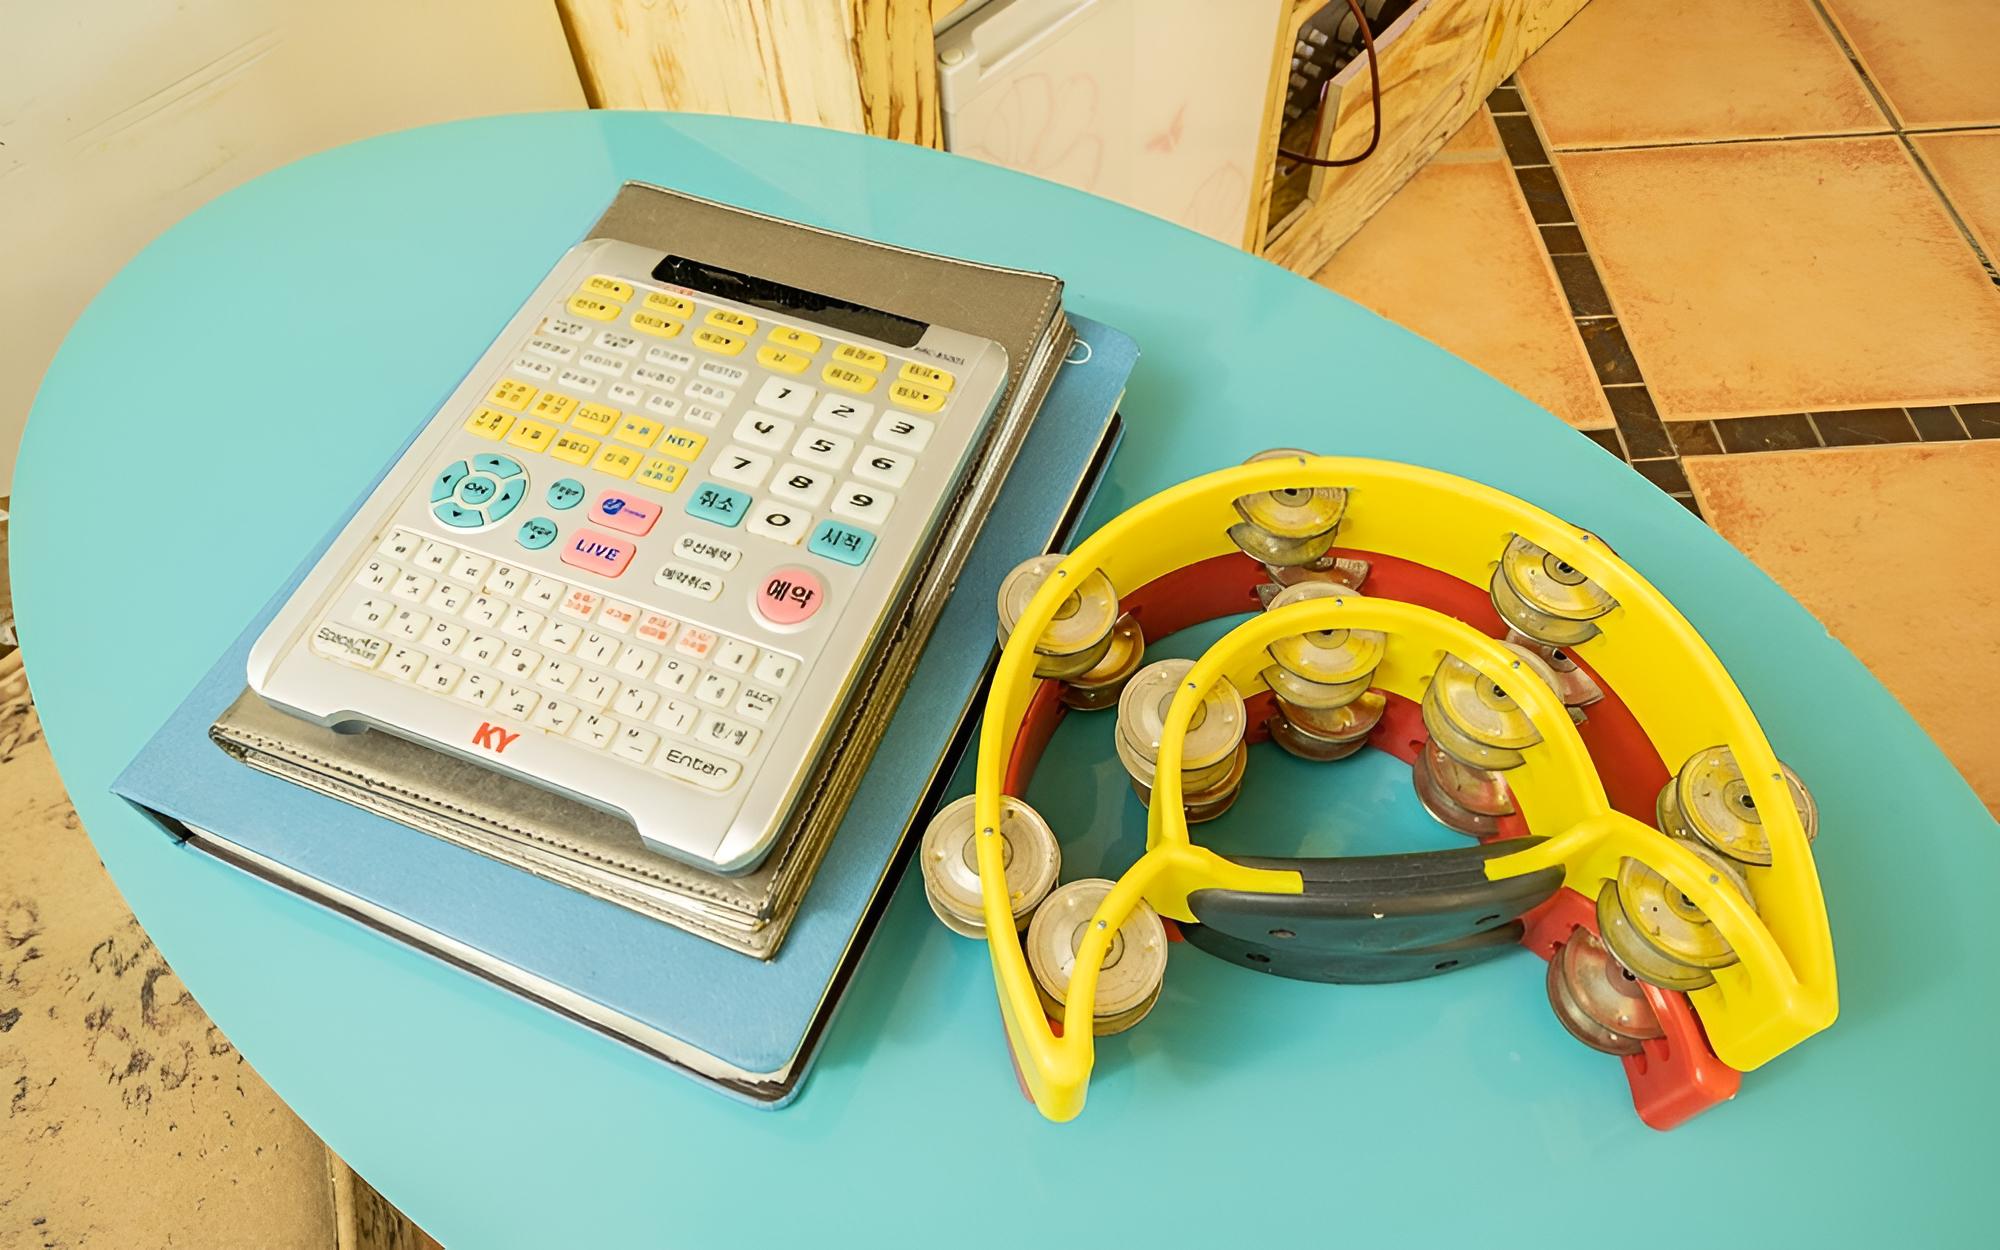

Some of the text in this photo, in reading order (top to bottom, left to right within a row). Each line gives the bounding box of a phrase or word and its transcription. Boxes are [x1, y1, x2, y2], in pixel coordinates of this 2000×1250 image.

[832, 405, 854, 417] 2
[891, 422, 914, 434] 3
[810, 440, 835, 452] 5
[734, 457, 751, 469] 7
[872, 458, 895, 469] 6
[789, 476, 813, 488] 8
[700, 491, 732, 512] 취소
[850, 494, 873, 506] 9
[821, 528, 861, 551] 시작
[576, 539, 619, 560] LIVE
[767, 580, 814, 608] 예약
[472, 722, 520, 754] KY
[667, 750, 727, 775] Enter
